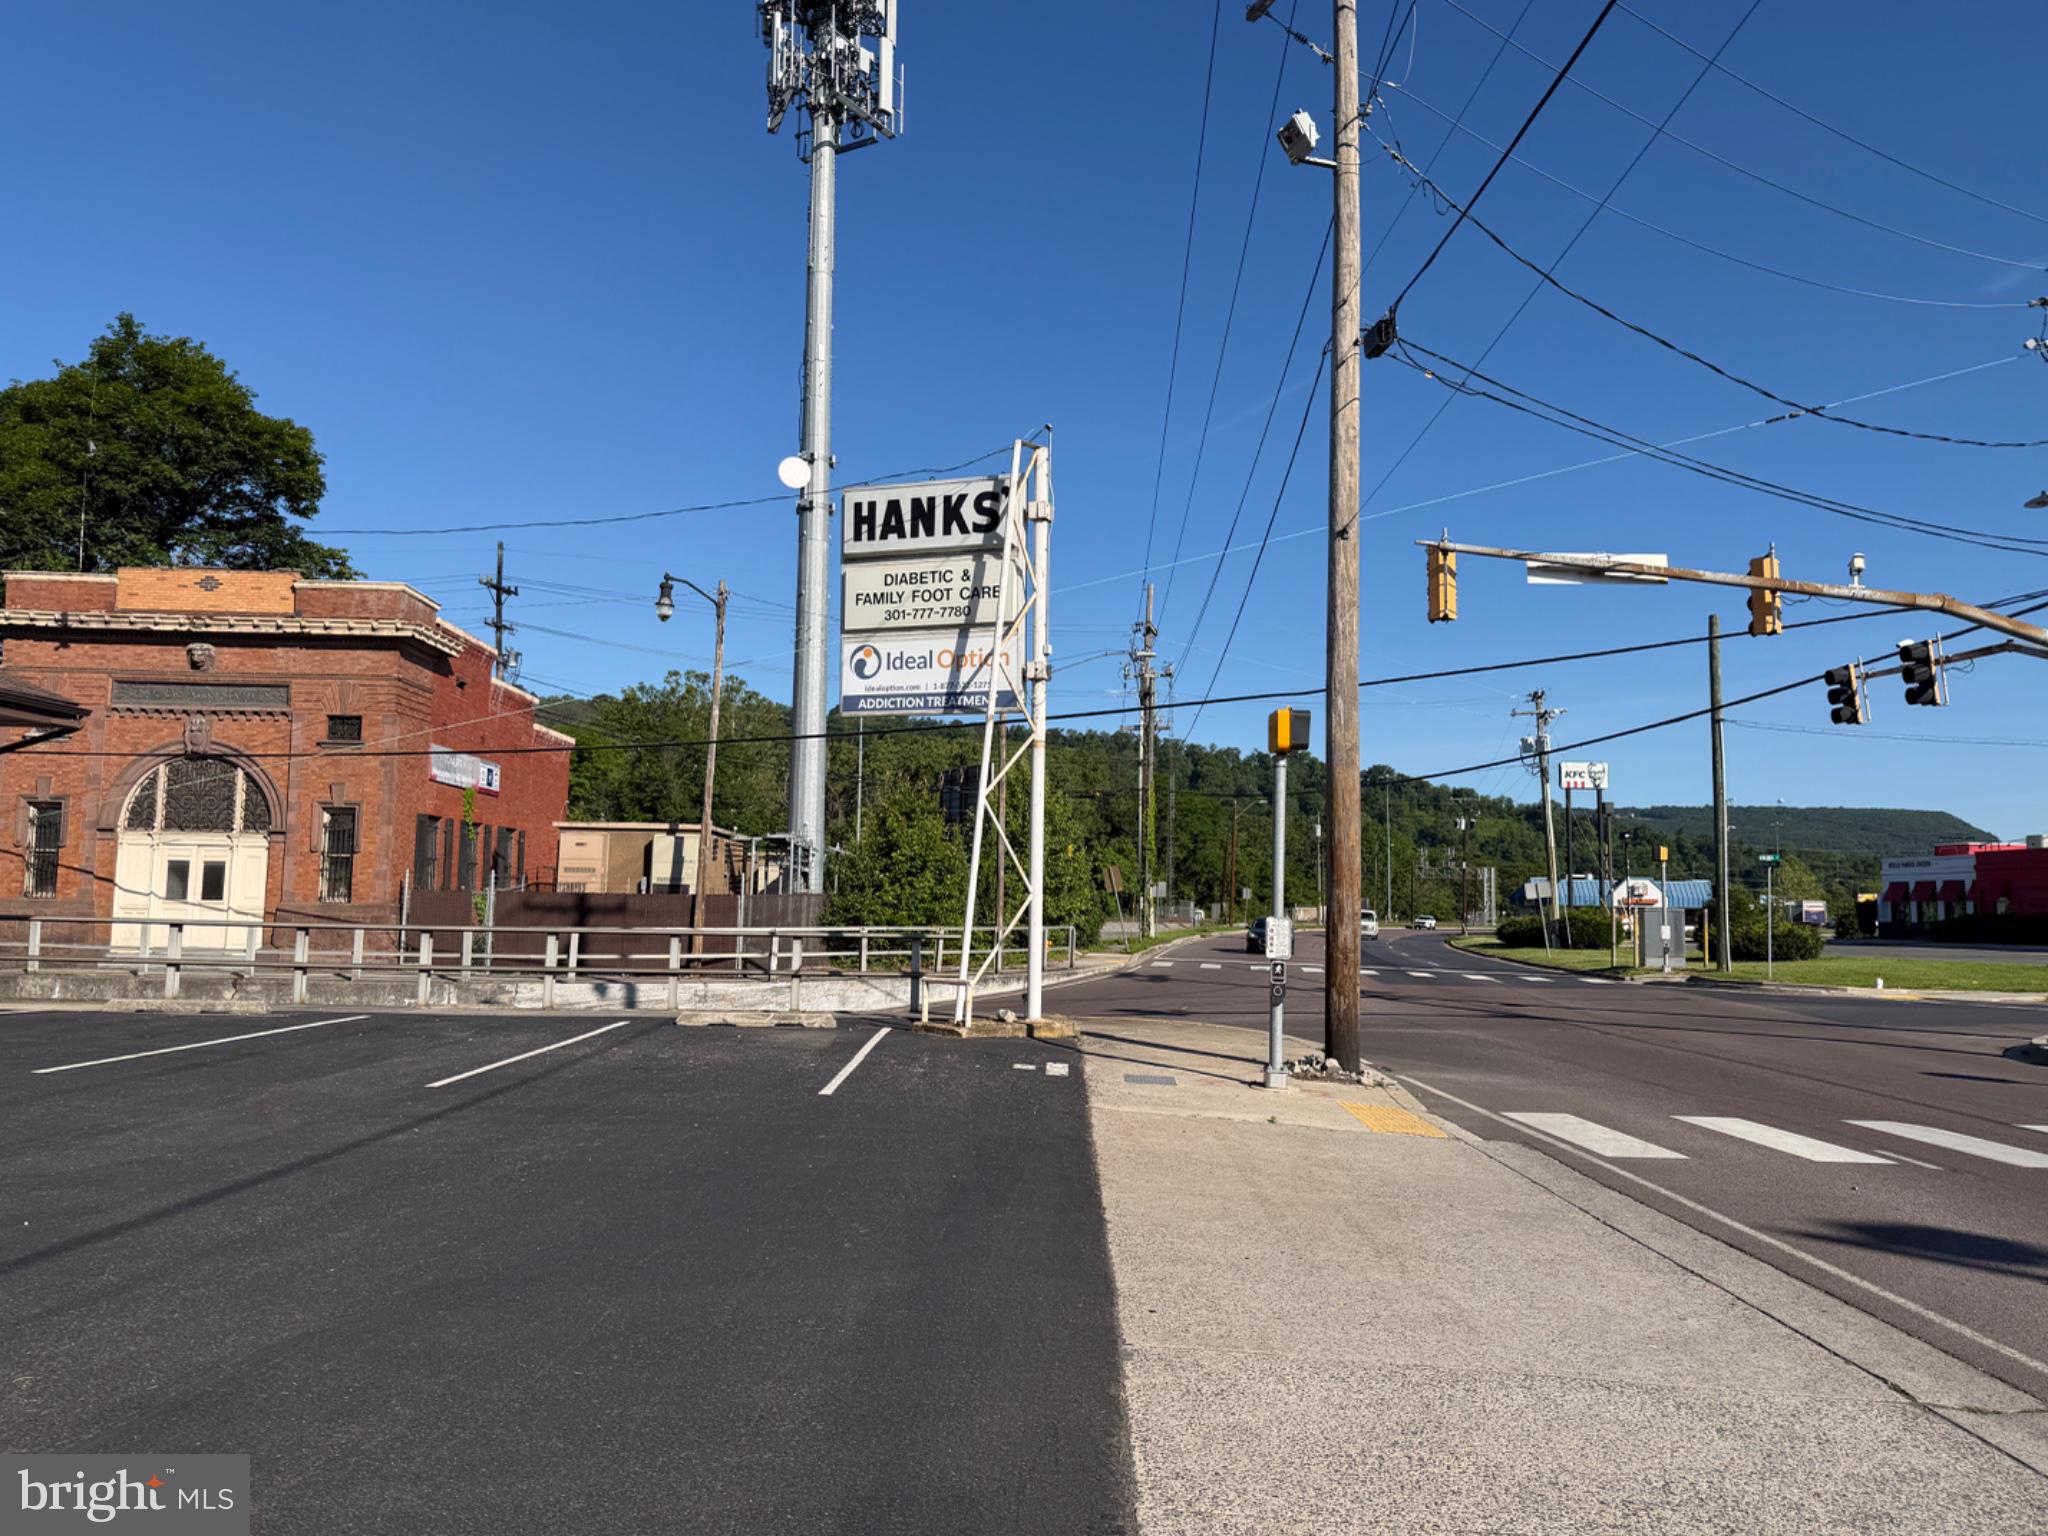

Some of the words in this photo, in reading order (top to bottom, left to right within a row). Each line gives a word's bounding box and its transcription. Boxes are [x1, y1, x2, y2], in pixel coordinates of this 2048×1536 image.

[884, 570, 953, 586] DIABETIC
[961, 569, 971, 581] &
[855, 591, 905, 606] FAMILY
[911, 588, 953, 602] FOOT
[959, 585, 1001, 601] CARE
[884, 605, 972, 621] 301-777-7780
[886, 649, 933, 671] Ideal
[865, 683, 921, 692] idealoption.com
[858, 697, 925, 709] ADDICTION
[926, 694, 999, 707] TREATMEN
[1564, 770, 1585, 779] KFC
